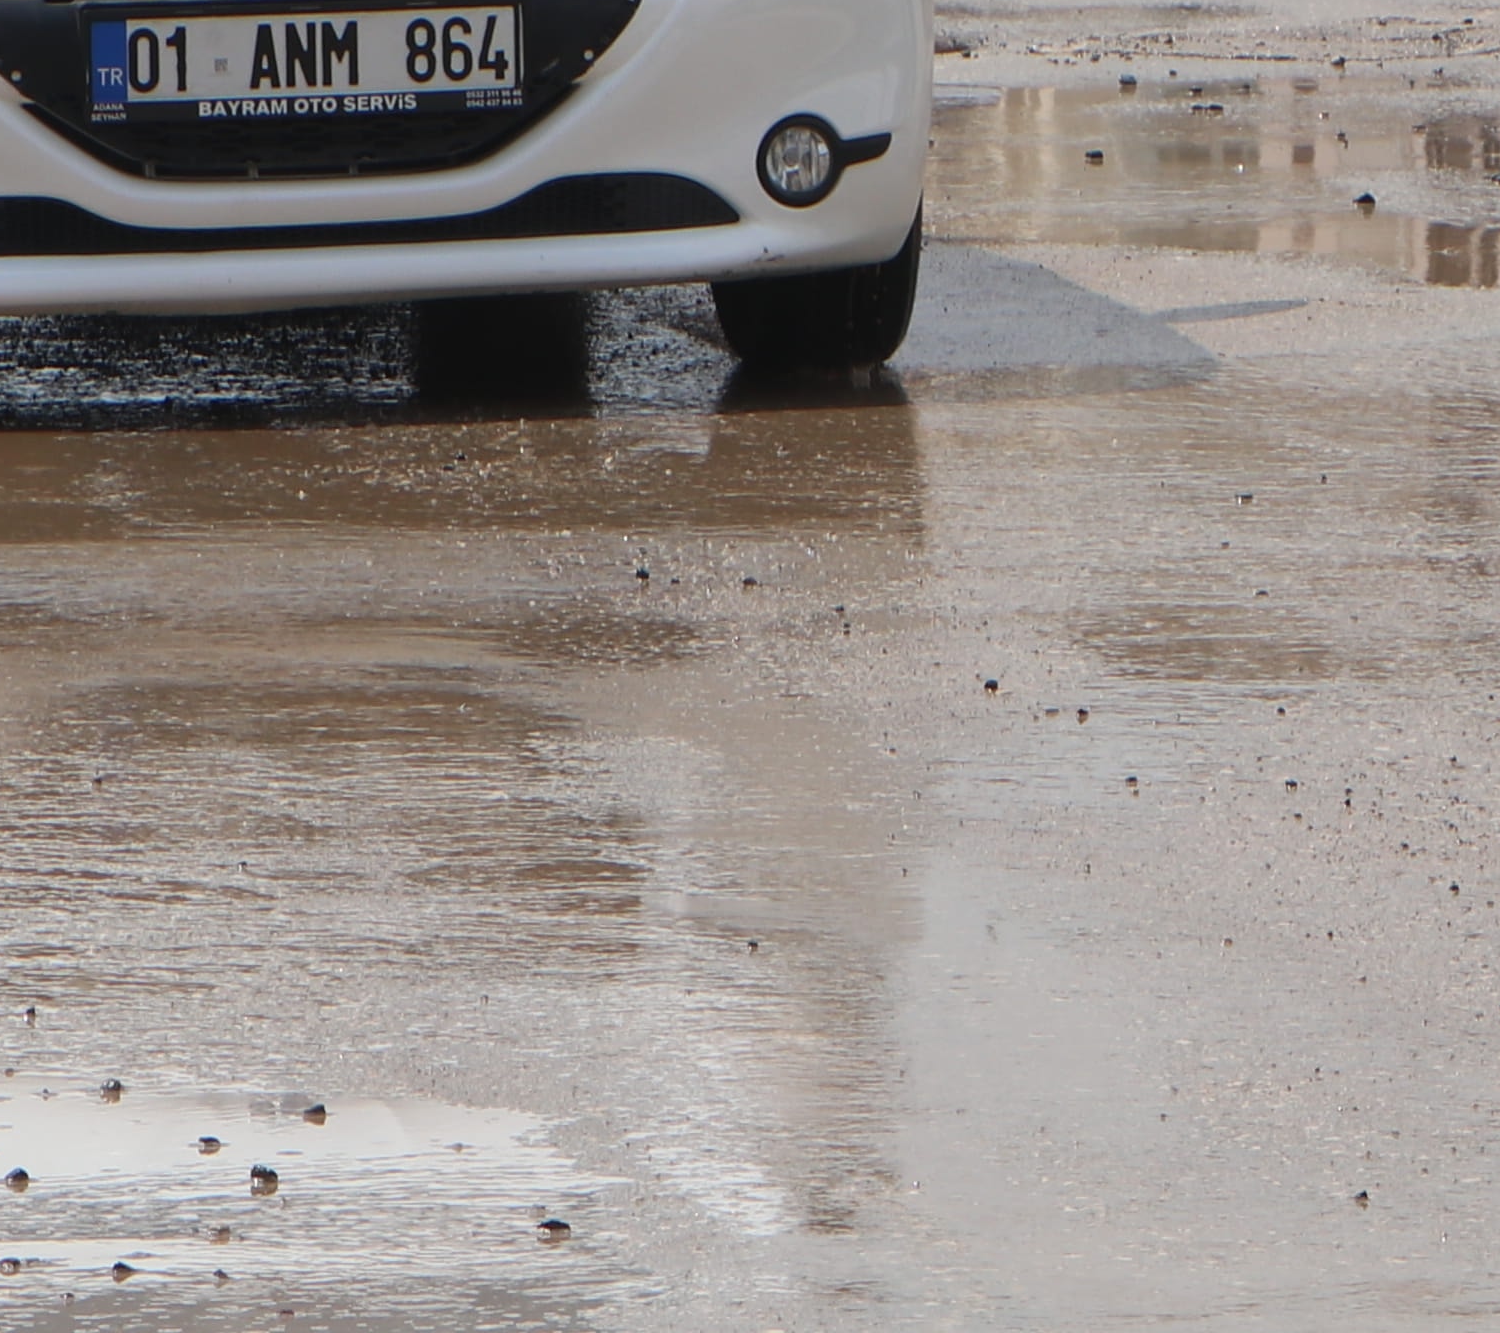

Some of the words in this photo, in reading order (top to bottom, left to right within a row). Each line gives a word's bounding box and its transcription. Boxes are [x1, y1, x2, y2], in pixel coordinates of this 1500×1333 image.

[98, 68, 123, 86] TR
[128, 26, 187, 93] 01
[249, 20, 359, 90] ANM
[406, 15, 509, 83] 864
[92, 103, 125, 112] ADANA
[199, 99, 289, 118] BAYRAM
[294, 97, 338, 115] OTO
[91, 112, 127, 122] SEYHAN
